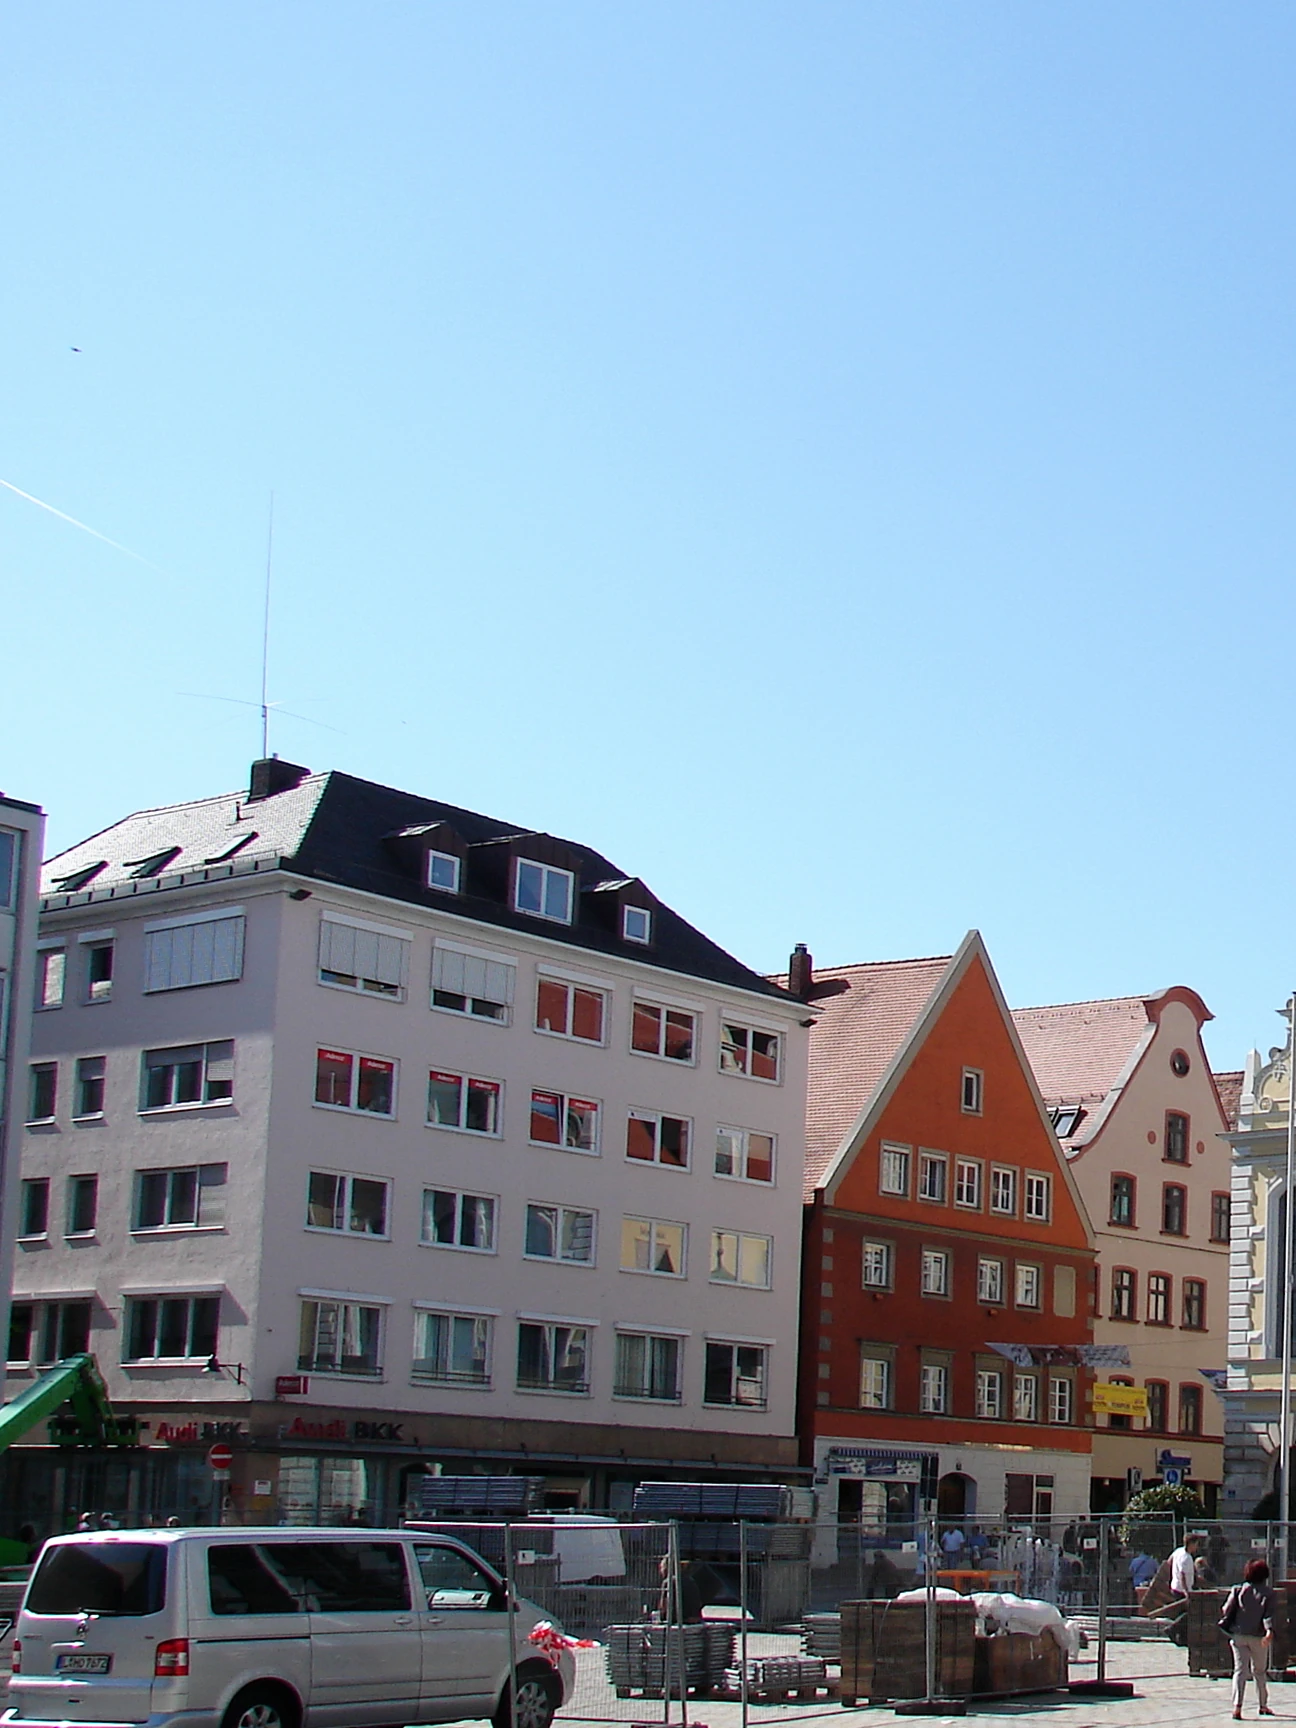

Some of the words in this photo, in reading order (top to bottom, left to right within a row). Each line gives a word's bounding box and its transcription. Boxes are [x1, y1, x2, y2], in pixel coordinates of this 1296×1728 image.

[154, 1420, 199, 1442] Audi
[287, 1416, 347, 1439] Audi
[354, 1420, 404, 1441] BKK
